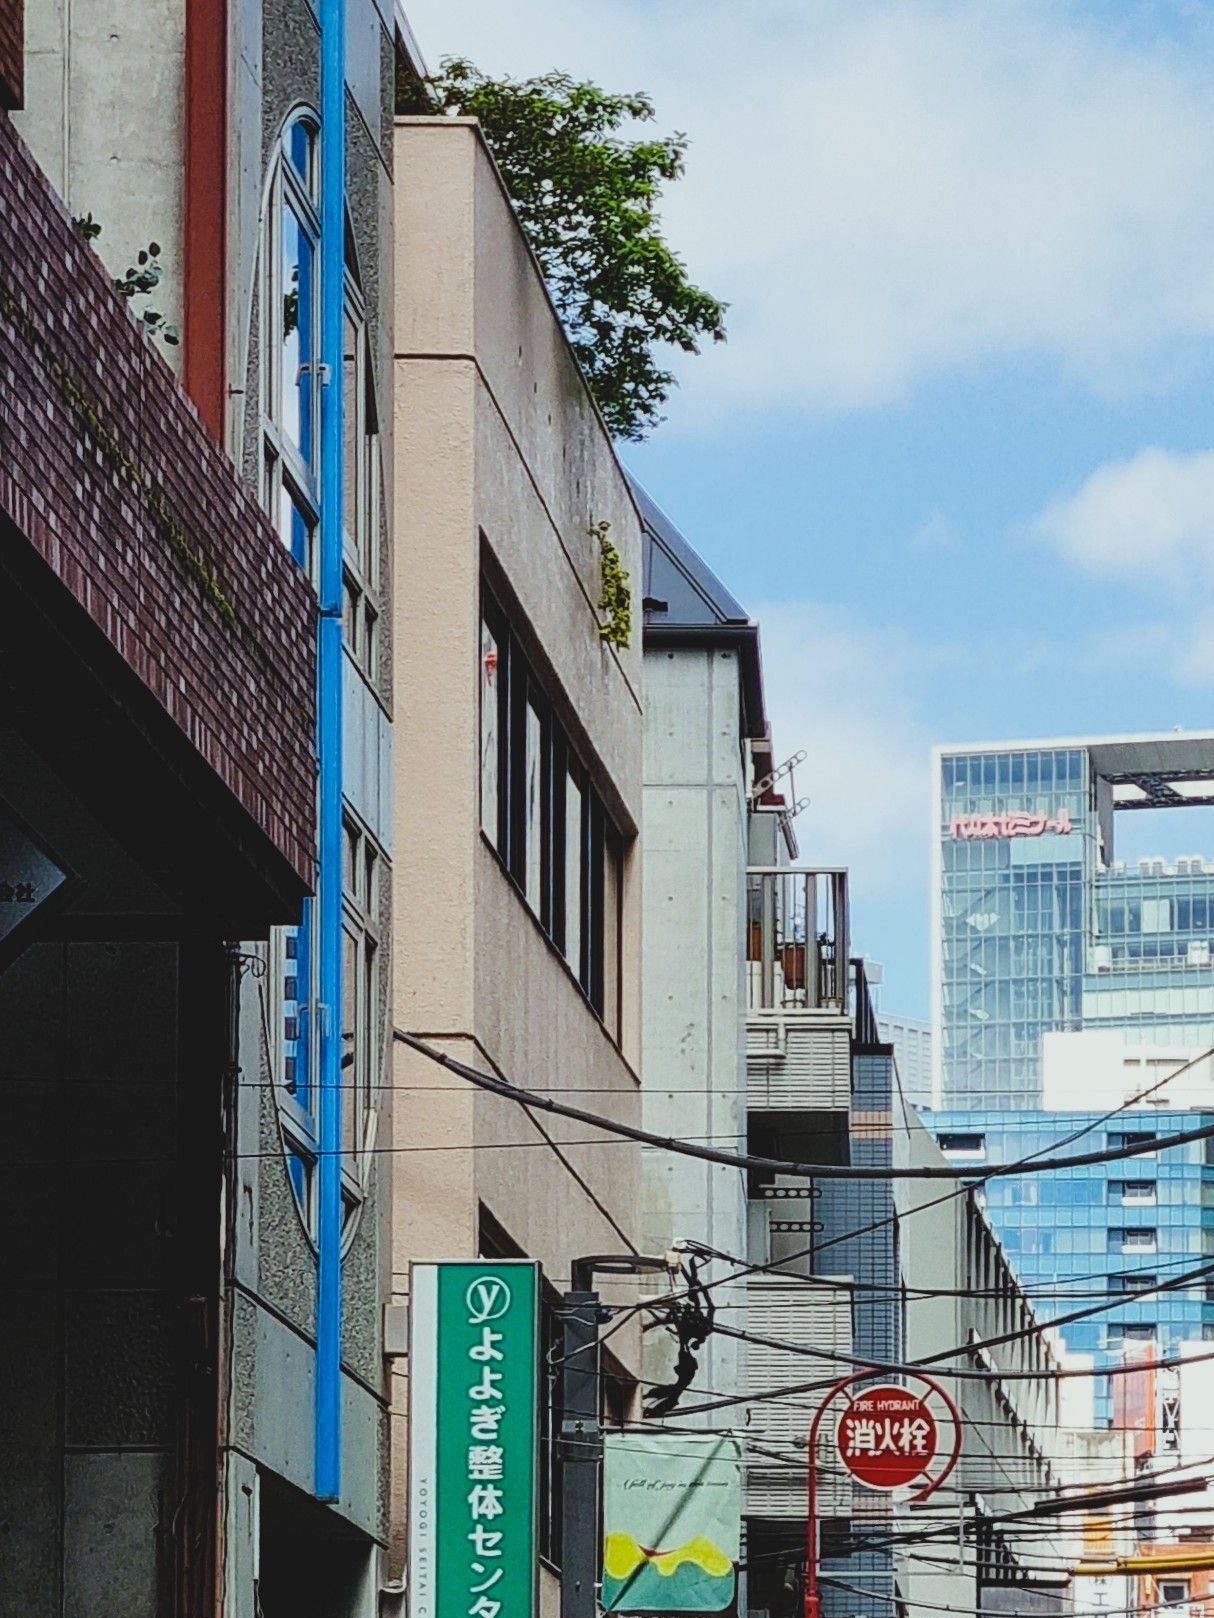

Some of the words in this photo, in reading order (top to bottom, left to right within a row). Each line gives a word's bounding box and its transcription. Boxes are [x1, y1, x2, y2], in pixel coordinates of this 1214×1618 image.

[853, 1400, 875, 1412] FIRE
[877, 1399, 920, 1412] HYDRANT
[845, 1417, 931, 1457] 消火栓
[417, 1478, 429, 1538] YOYOGI
[417, 1547, 428, 1597] SEITAI
